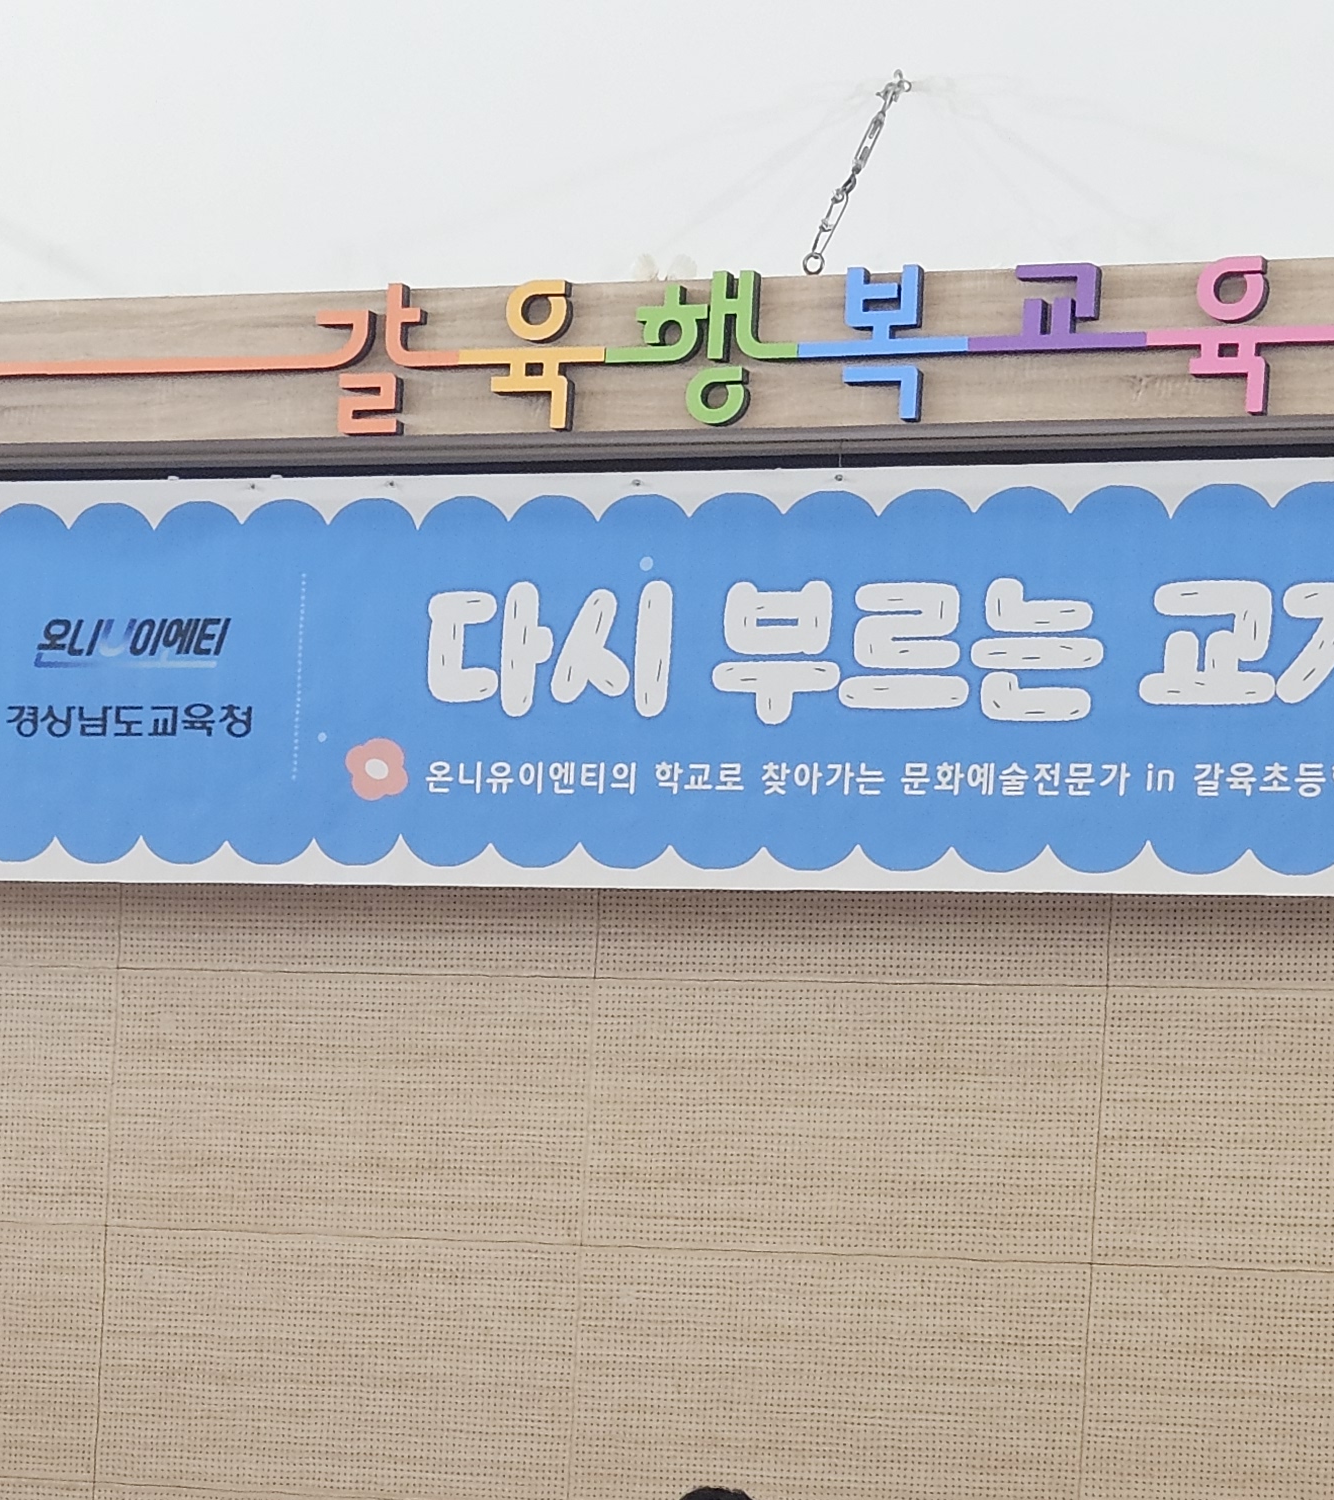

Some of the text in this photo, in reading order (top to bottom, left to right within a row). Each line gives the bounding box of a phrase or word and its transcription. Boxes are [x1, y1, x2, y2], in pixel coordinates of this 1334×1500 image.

[427, 579, 674, 718] 다시
[711, 577, 1105, 726] 부르는
[6, 702, 254, 739] 경상남도교육청
[424, 760, 638, 796] 온니유이엔티의
[654, 760, 746, 796] 학교로
[760, 760, 887, 797] 찾아가는
[899, 760, 1132, 798] 문화예술전문가
[1145, 761, 1176, 793] in
